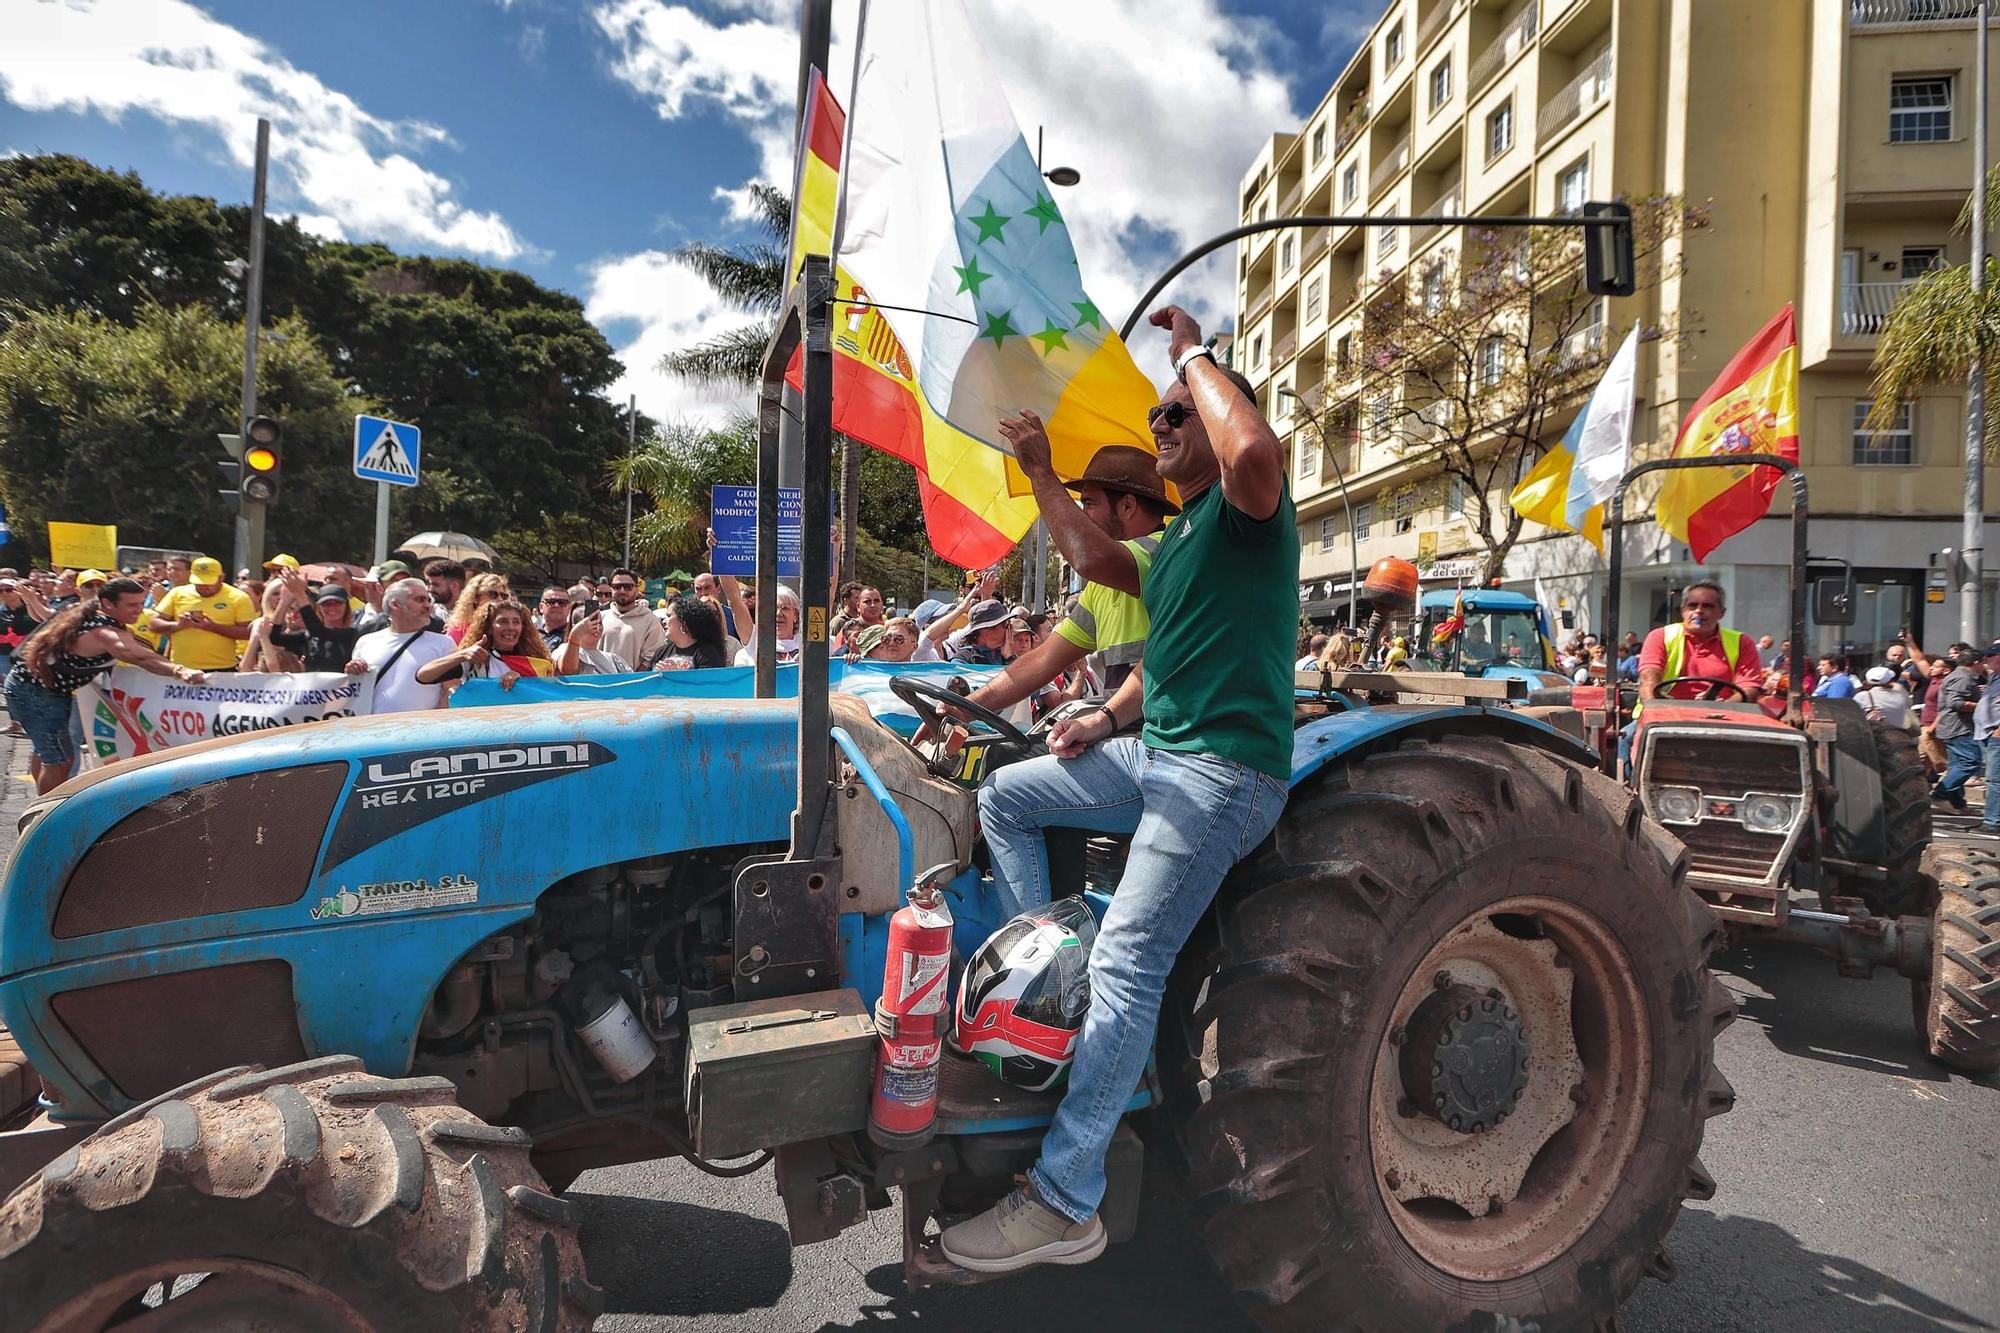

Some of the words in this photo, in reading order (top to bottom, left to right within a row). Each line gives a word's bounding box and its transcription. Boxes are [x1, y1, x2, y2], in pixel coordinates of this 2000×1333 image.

[783, 510, 801, 518] DEL
[1433, 569, 1449, 577] del
[1451, 566, 1476, 576] café
[160, 709, 205, 736] STOP
[368, 743, 589, 783] LANDINI
[426, 778, 486, 800] 120F
[441, 875, 475, 889] S.L.
